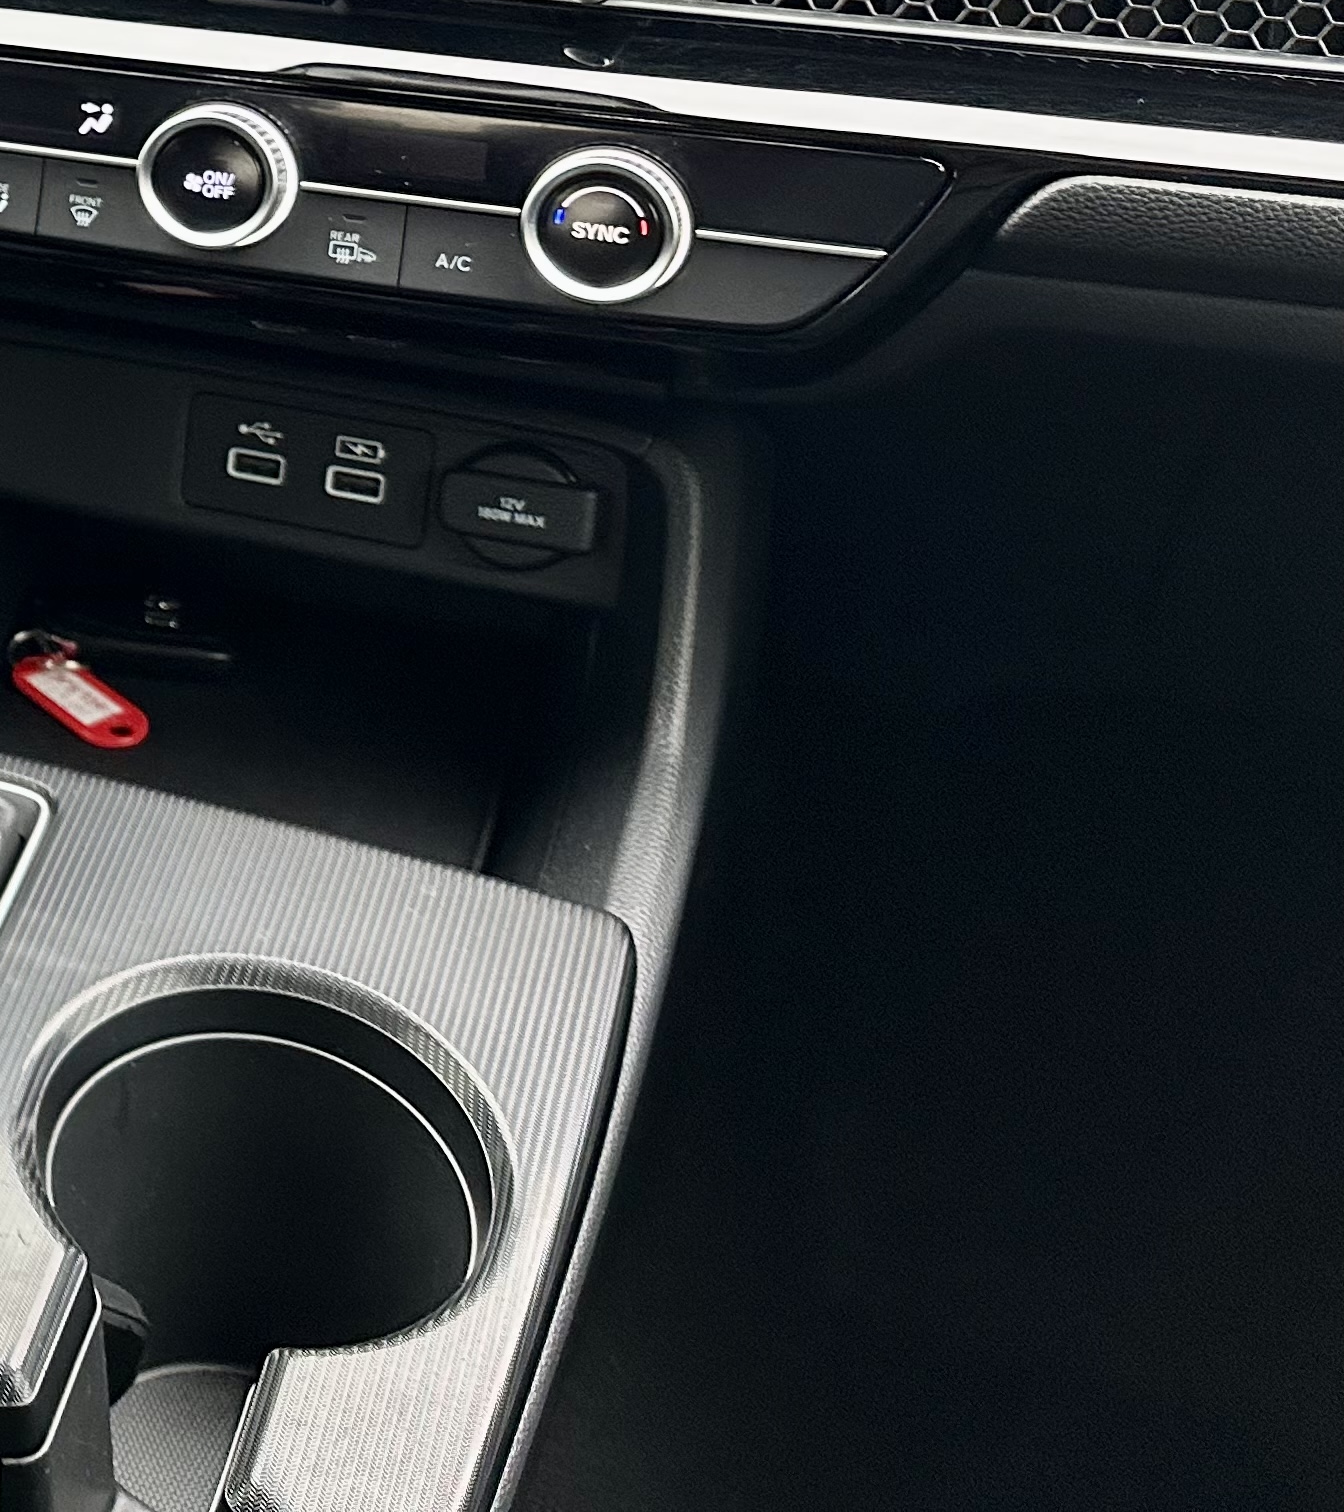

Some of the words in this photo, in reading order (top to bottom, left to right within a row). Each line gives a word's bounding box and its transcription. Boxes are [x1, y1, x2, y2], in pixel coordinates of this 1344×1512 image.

[202, 170, 236, 186] ON/
[202, 184, 236, 200] OFF
[69, 193, 103, 208] FRONT
[330, 230, 361, 243] REAR
[571, 221, 631, 245] SYNC
[435, 253, 473, 272] A/C
